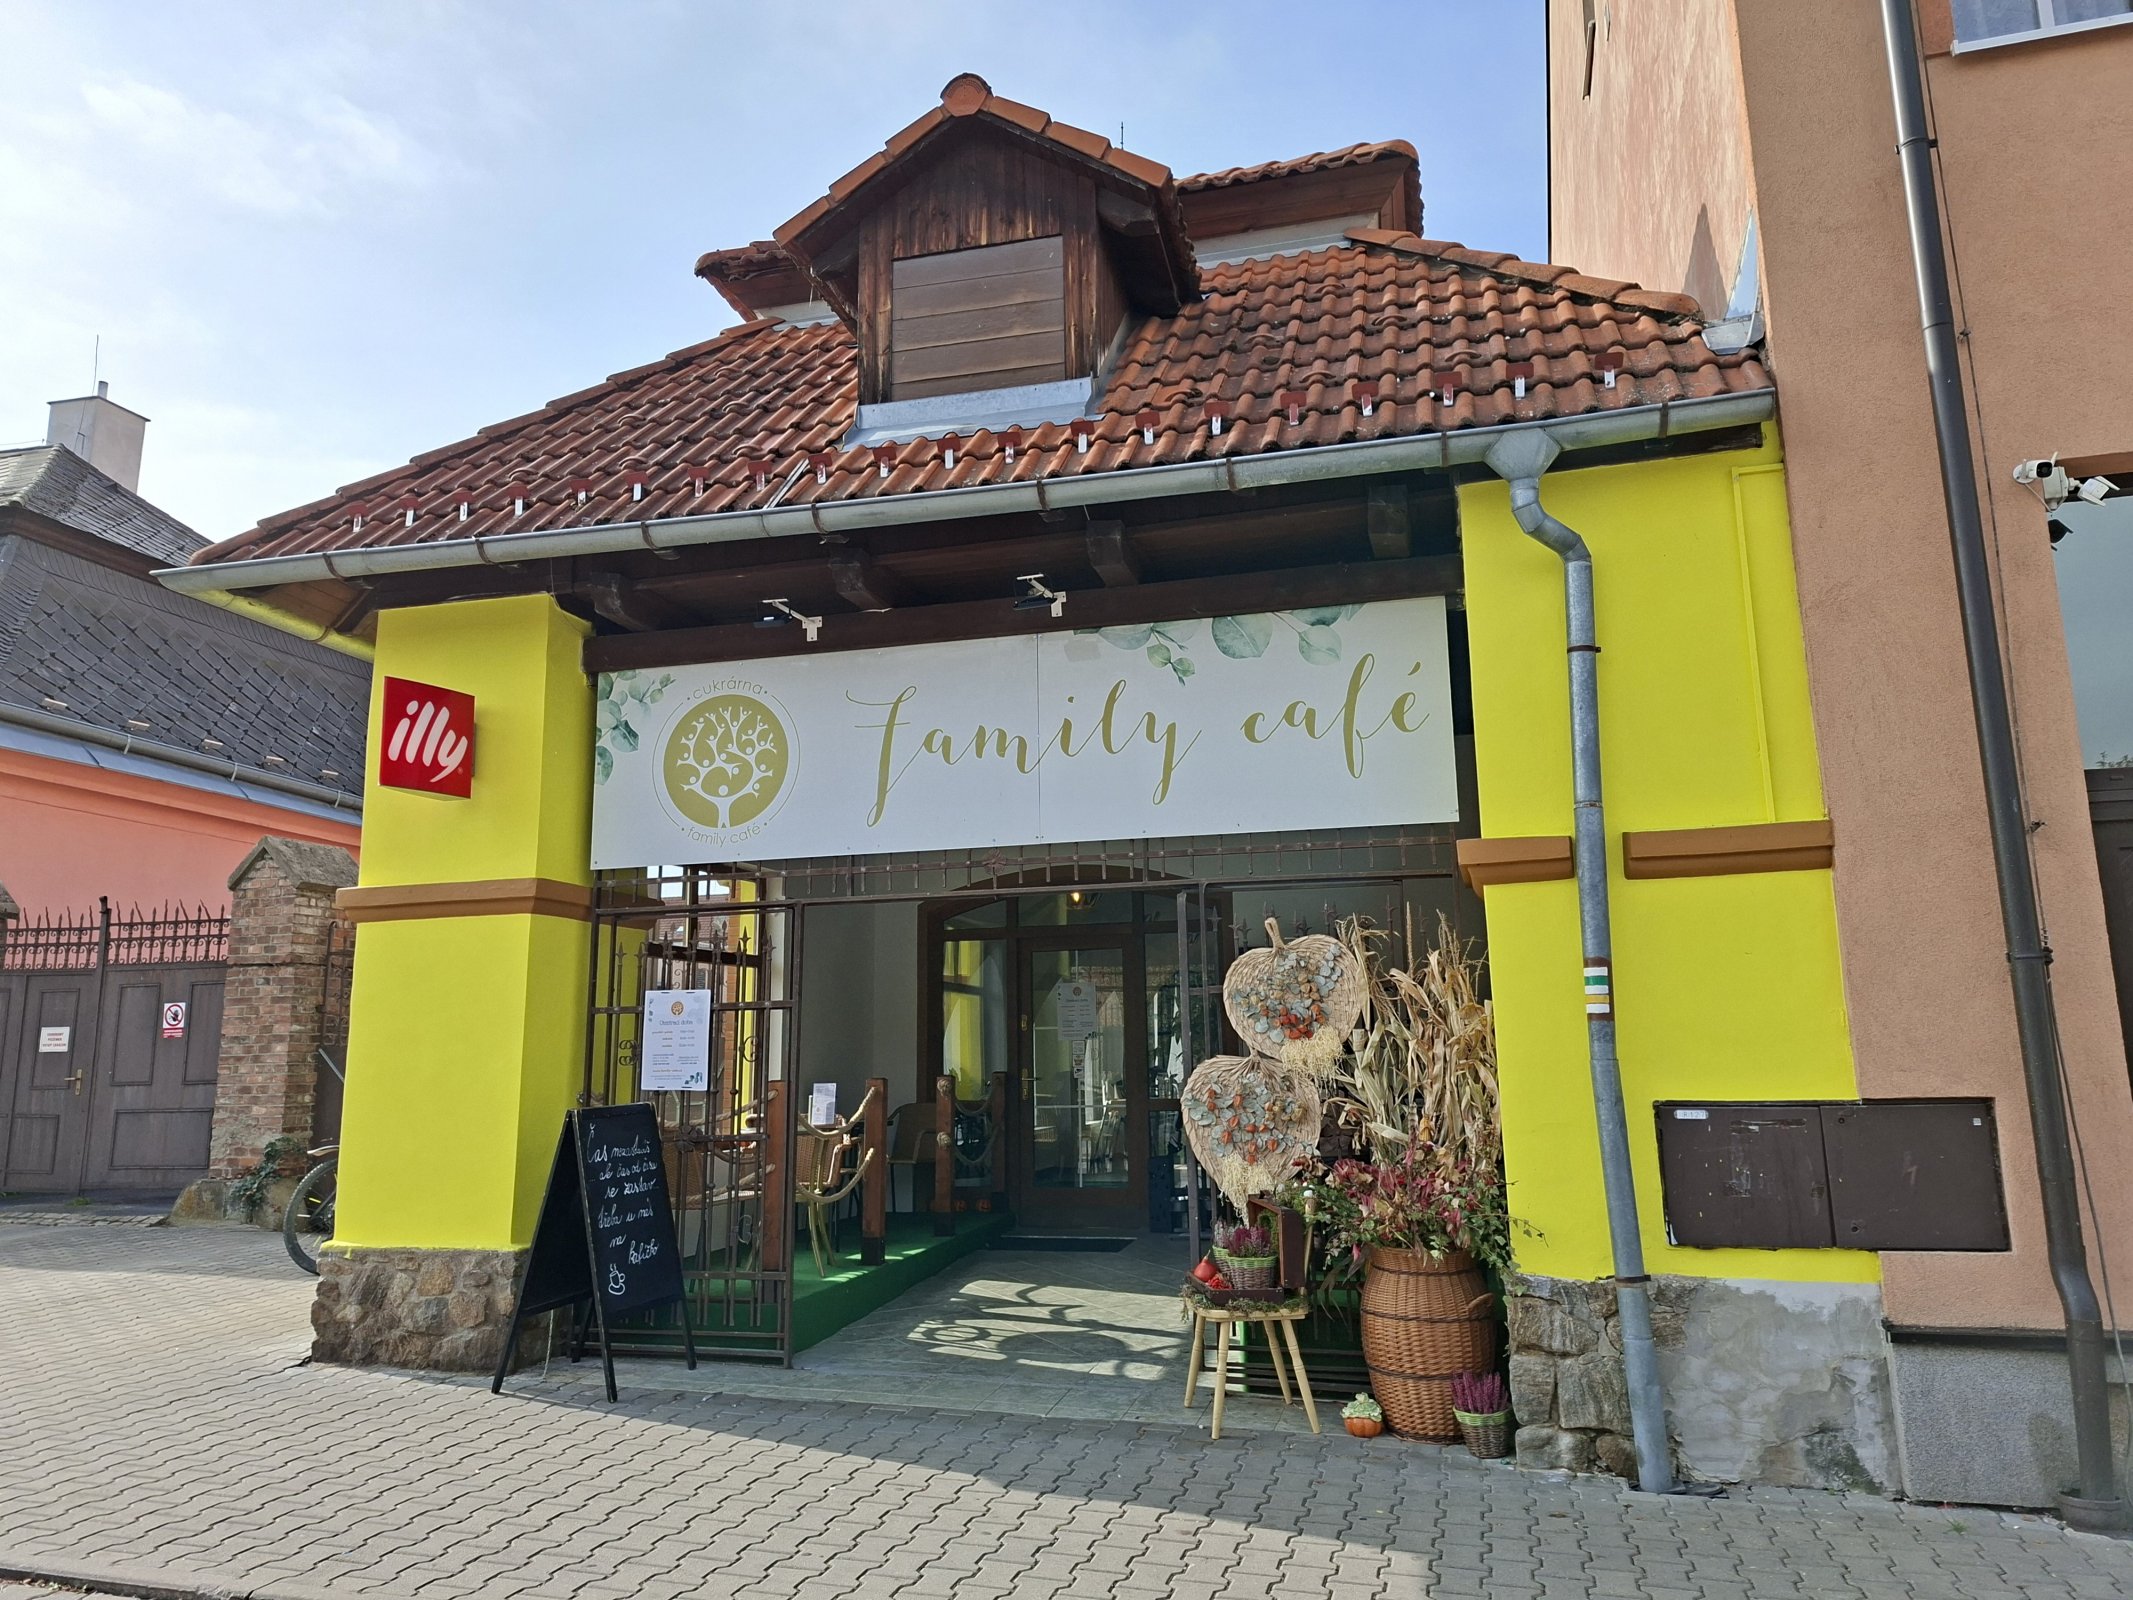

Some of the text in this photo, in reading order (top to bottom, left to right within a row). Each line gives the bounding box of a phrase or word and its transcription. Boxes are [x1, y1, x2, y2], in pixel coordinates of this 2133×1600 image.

[693, 675, 763, 700] cukrárna
[387, 700, 468, 783] illy
[846, 653, 1430, 828] Family café
[687, 823, 761, 847] family café
[605, 1186, 619, 1199] se
